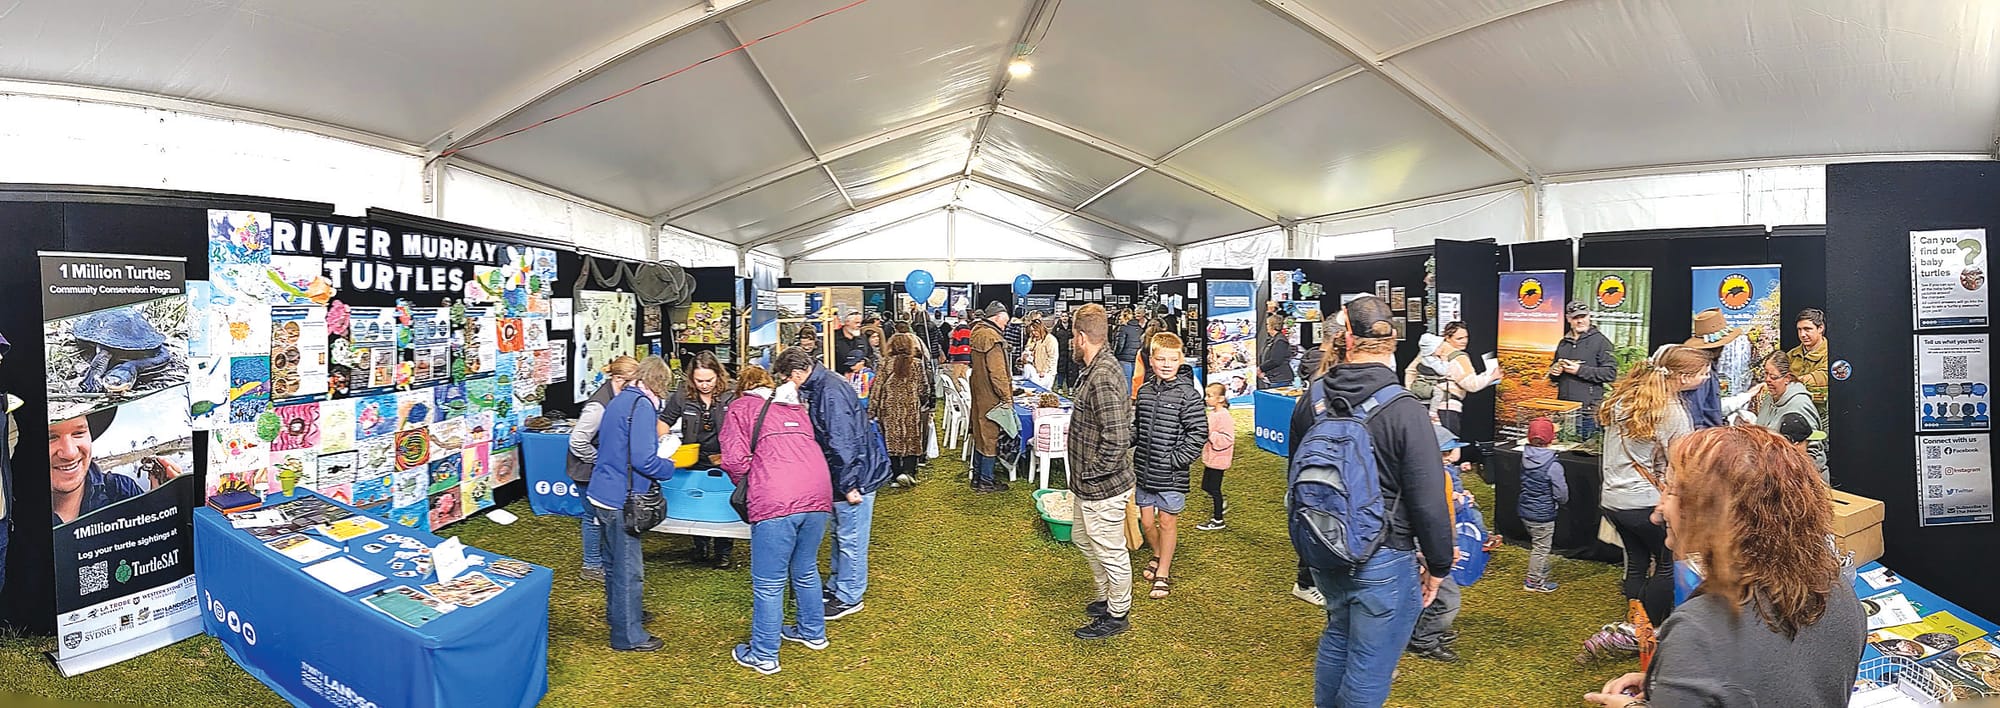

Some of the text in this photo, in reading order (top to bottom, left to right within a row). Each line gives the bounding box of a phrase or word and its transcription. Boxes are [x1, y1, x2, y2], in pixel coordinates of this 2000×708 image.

[272, 218, 497, 263] RIVER MURRAY
[1940, 236, 1957, 245] you
[1920, 258, 1944, 267] baby
[59, 264, 171, 280] 1 Million Turtles
[323, 259, 464, 292] TURTLES
[1921, 269, 1951, 277] turtles
[49, 285, 180, 296] Community Conservation Program
[73, 506, 178, 540] 1MillionTurtles.com
[77, 528, 178, 560] Log your turtle sightings at
[131, 549, 180, 577] TurtleSAT
[141, 588, 166, 599] WESTERN
[166, 583, 184, 593] SYDNEY
[110, 599, 131, 609] TROBE
[164, 595, 198, 612] LANDSCAPE
[84, 627, 118, 642] SYDNEY
